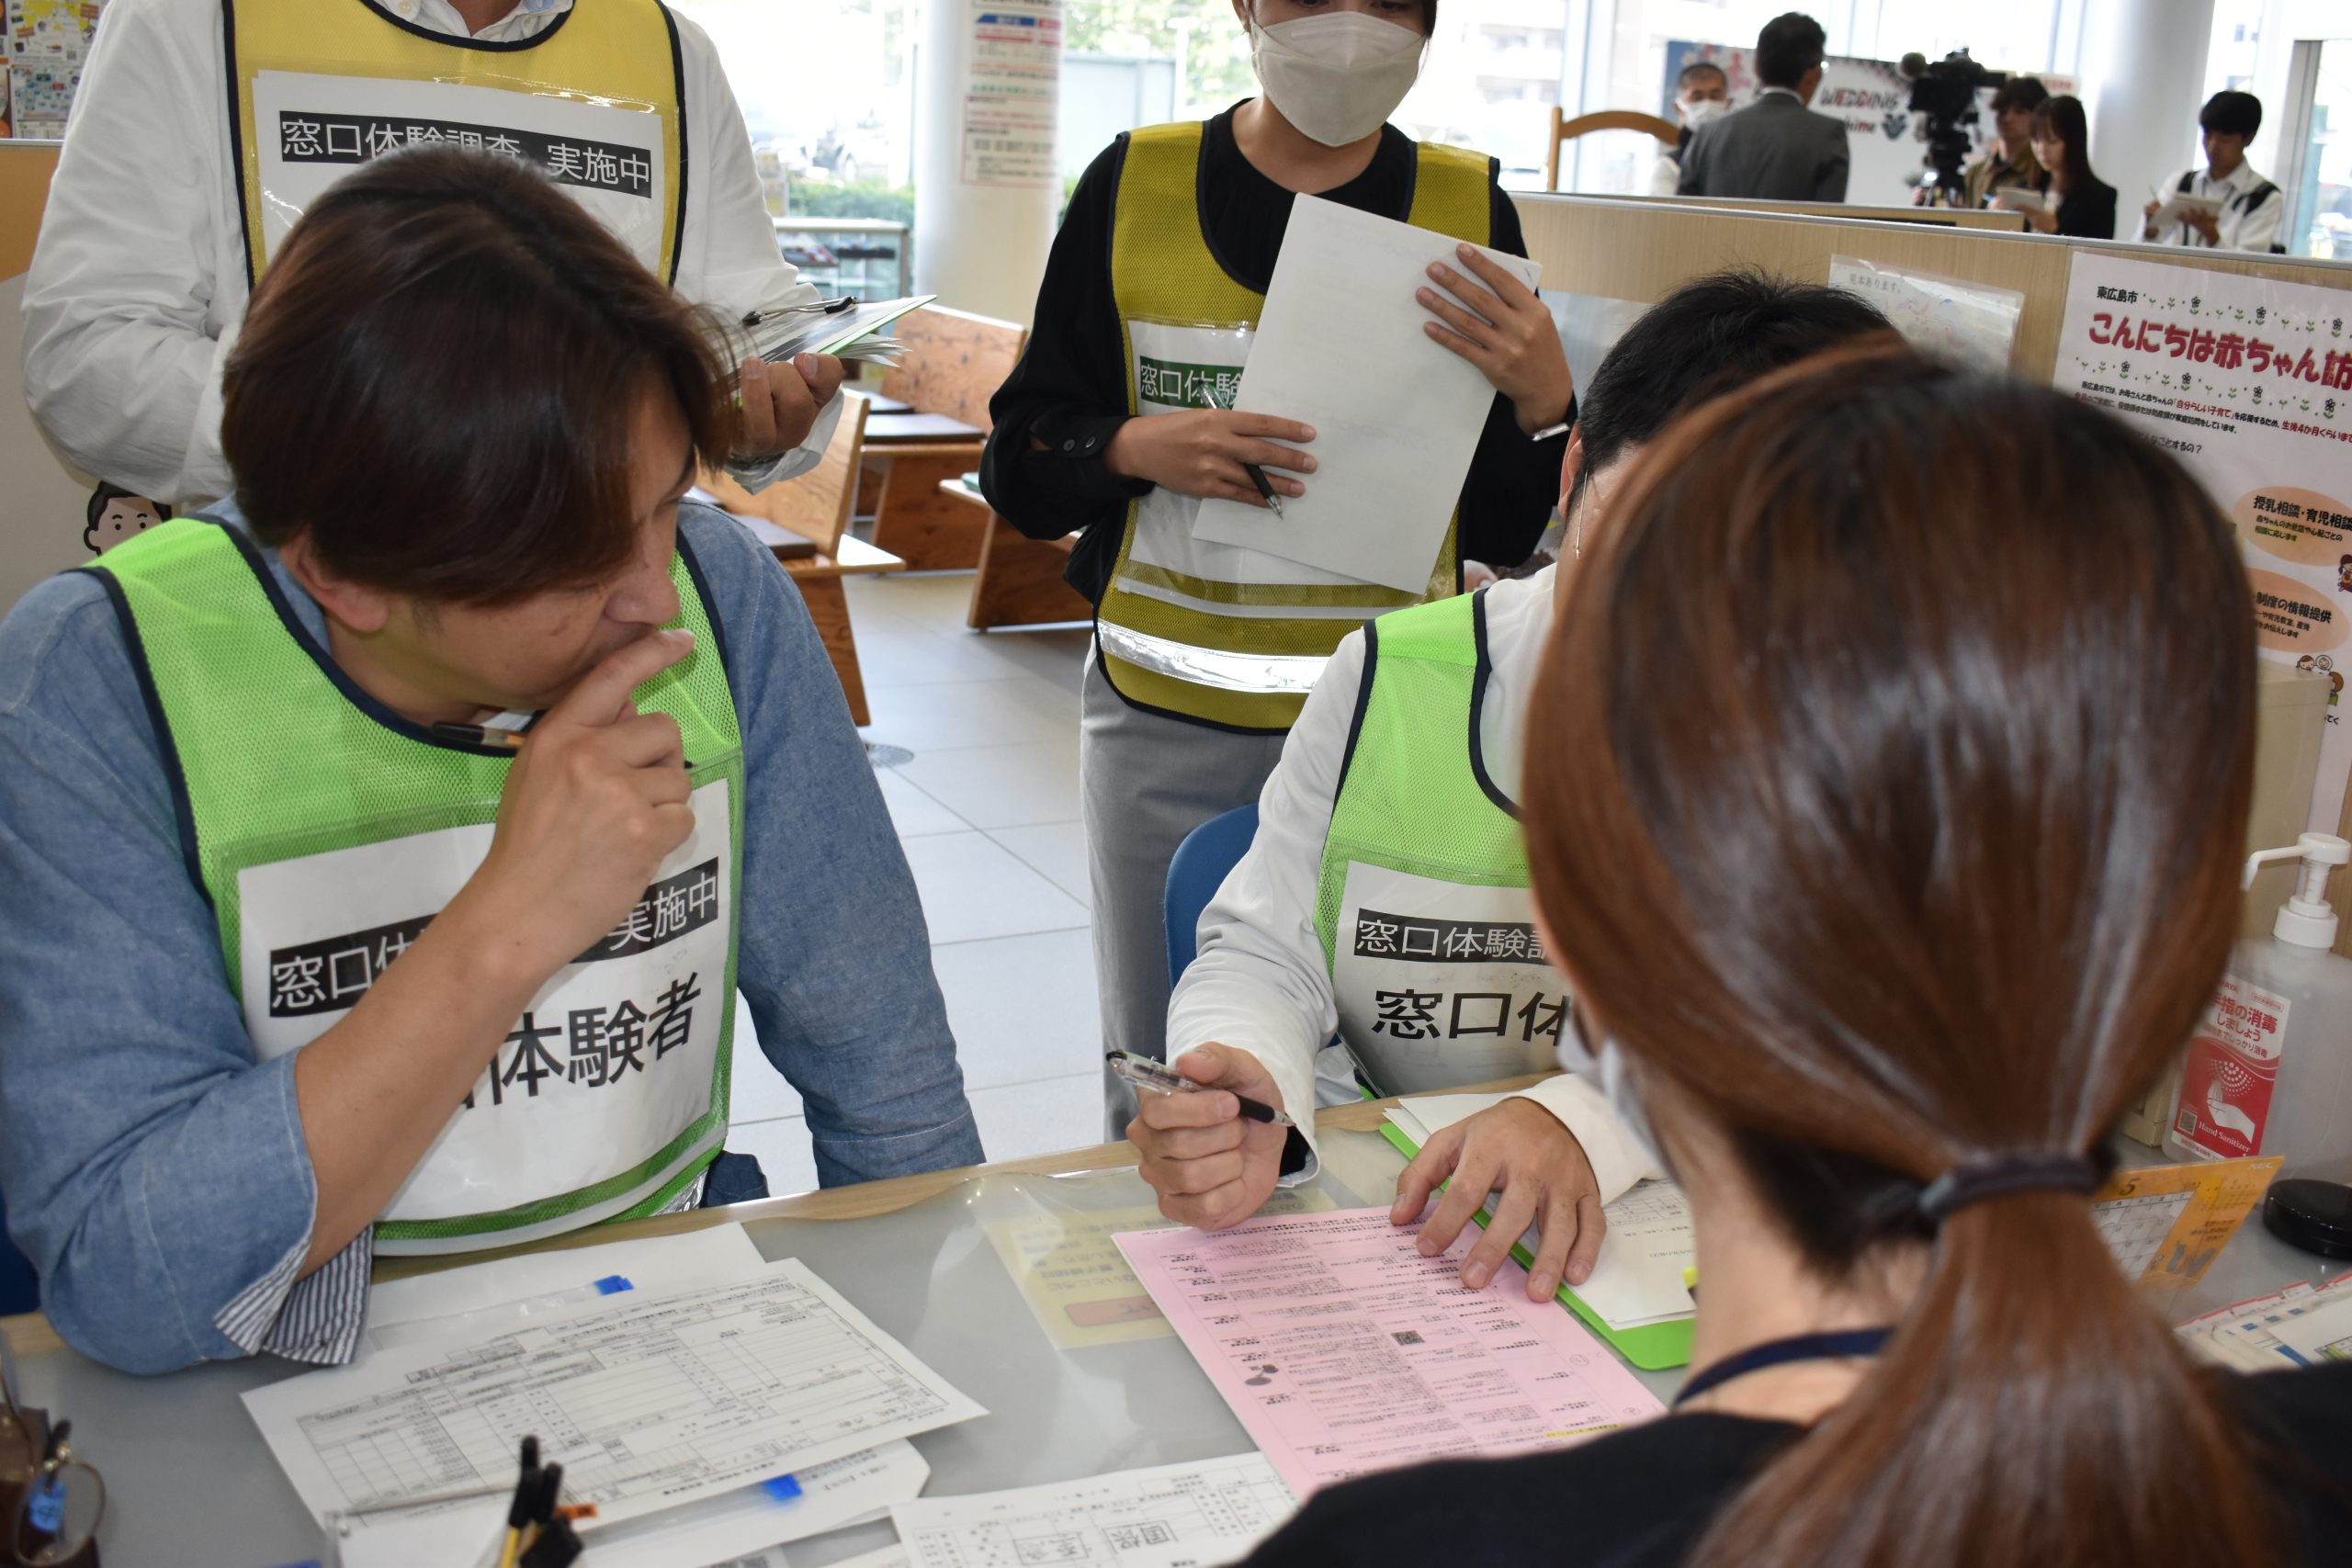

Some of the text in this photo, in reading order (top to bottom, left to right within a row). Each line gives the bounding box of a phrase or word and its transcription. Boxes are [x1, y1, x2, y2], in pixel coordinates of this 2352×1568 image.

[548, 143, 650, 189] 実施中
[2097, 286, 2138, 304] 東広島市
[608, 873, 717, 952] 実施中
[466, 972, 702, 1109] 体験者
[1371, 989, 1569, 1047] 窓口体
[2217, 1012, 2262, 1043] しましょう
[2199, 1121, 2218, 1137] Hand
[2219, 1132, 2251, 1153] Sanitizer
